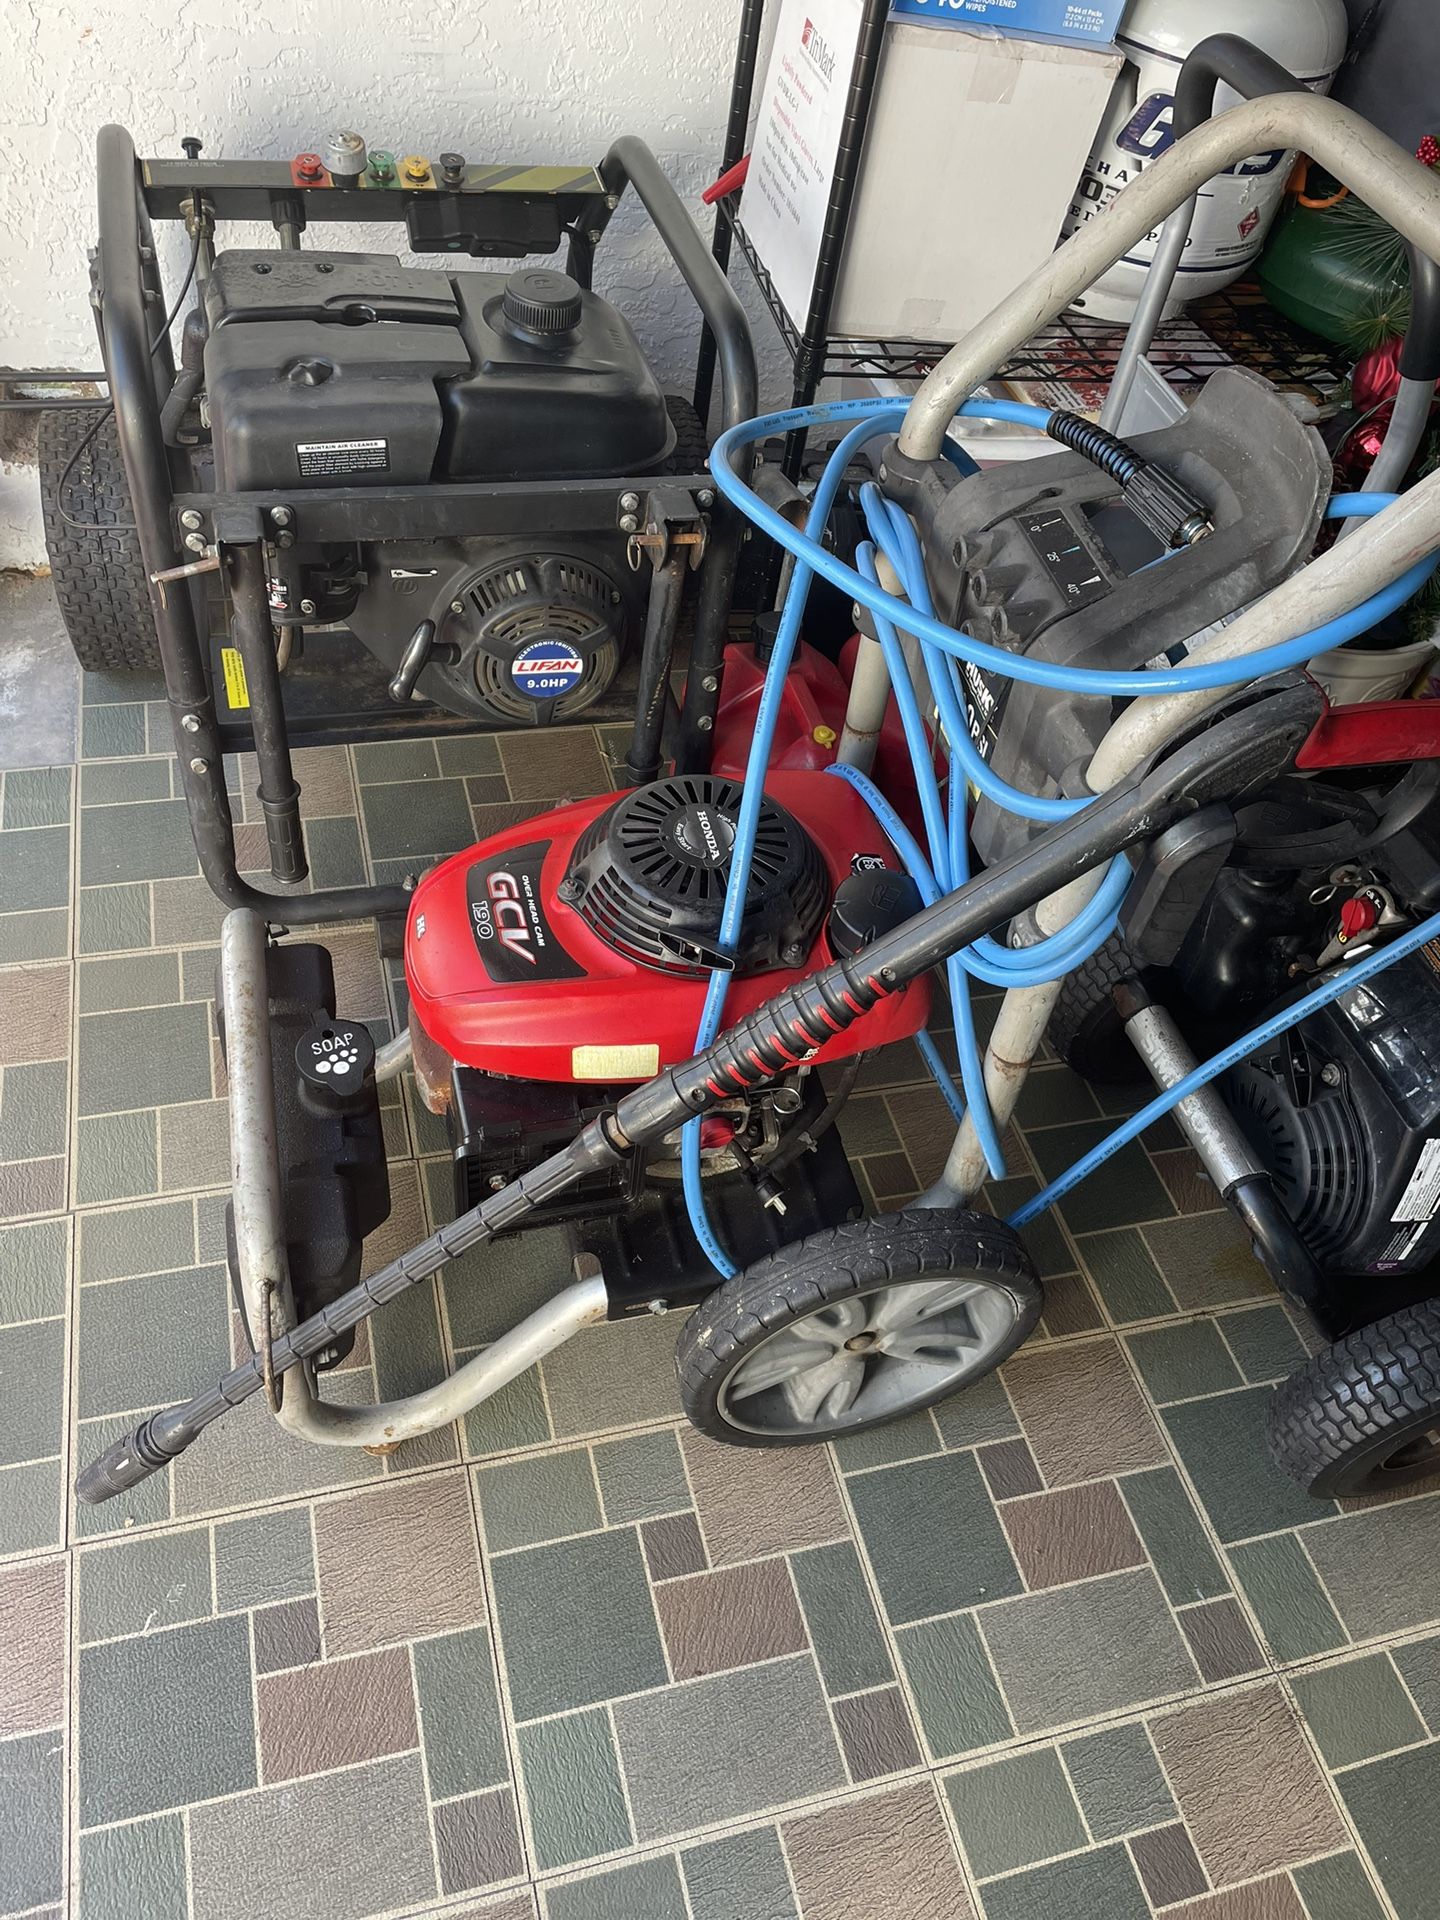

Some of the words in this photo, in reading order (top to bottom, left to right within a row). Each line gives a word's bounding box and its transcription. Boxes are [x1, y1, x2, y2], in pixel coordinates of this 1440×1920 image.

[965, 2, 987, 13] WIPES
[808, 27, 836, 83] TriMark
[813, 159, 825, 184] Large
[349, 441, 379, 449] CLEANER
[518, 640, 555, 660] ELECTRONIC
[555, 640, 579, 659] IGNITION
[517, 660, 579, 672] LIFAN
[527, 678, 568, 689] 9.0HP
[675, 822, 684, 836] Easy
[696, 810, 720, 861] HONDA
[677, 835, 692, 851] Start
[471, 900, 494, 940] 190
[486, 871, 537, 965] GCV
[521, 874, 533, 898] OVER
[527, 898, 540, 925] HEAD
[534, 924, 546, 947] CAM
[311, 1032, 353, 1055] SOAP
[1140, 1031, 1227, 1155] SIMSON
